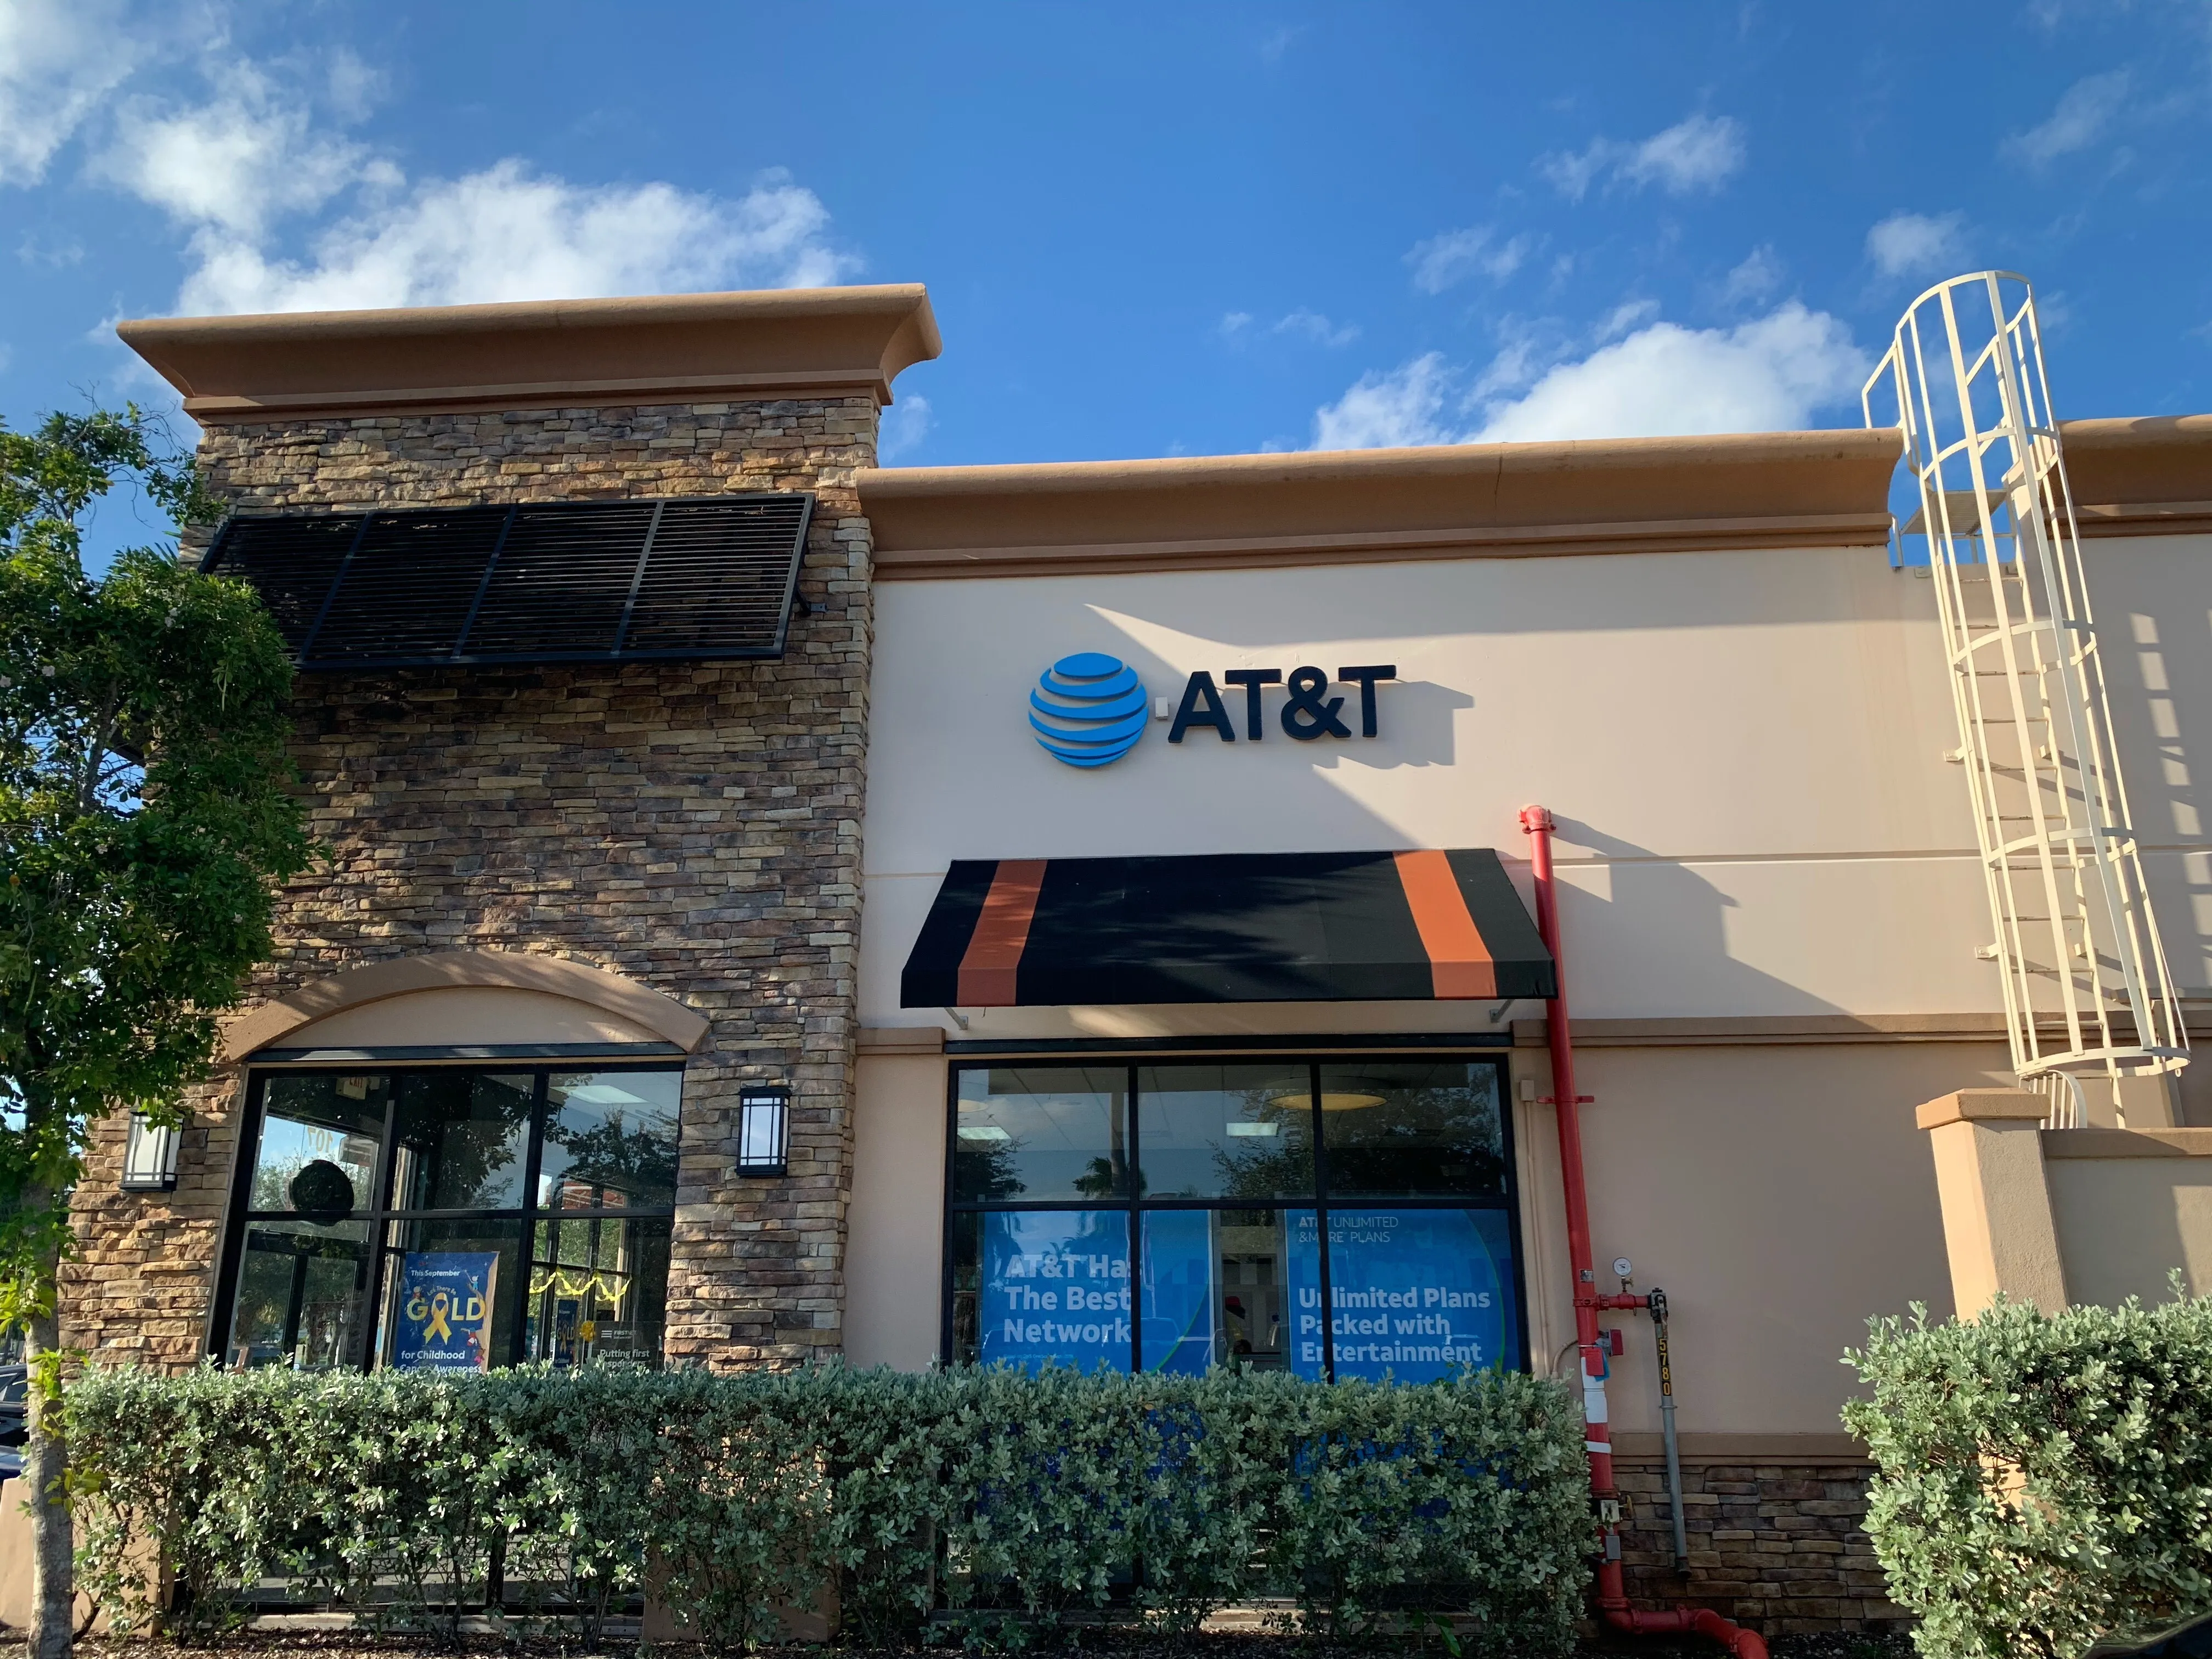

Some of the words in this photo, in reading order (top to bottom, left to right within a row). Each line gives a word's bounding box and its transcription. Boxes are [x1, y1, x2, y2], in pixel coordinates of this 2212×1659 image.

[1168, 664, 1397, 743] AT&T
[1333, 1216, 1398, 1228] UNLIMITED
[1299, 1232, 1345, 1243] &MRE
[1350, 1231, 1391, 1243] PLANS
[425, 1269, 461, 1278] September
[1004, 1254, 1081, 1278] AT&T
[1088, 1254, 1141, 1278] Ha
[406, 1293, 486, 1321] GOLD
[1004, 1284, 1058, 1310] The
[1066, 1286, 1131, 1310] Best
[1424, 1286, 1491, 1308] Plans
[1004, 1317, 1132, 1342] Network
[1394, 1313, 1451, 1335] with
[401, 1350, 415, 1359] for
[416, 1350, 465, 1359] Childhood
[600, 1349, 631, 1359] Putting
[632, 1349, 650, 1358] first
[433, 1364, 482, 1373] Awareness
[1658, 1338, 1672, 1395] 5780
